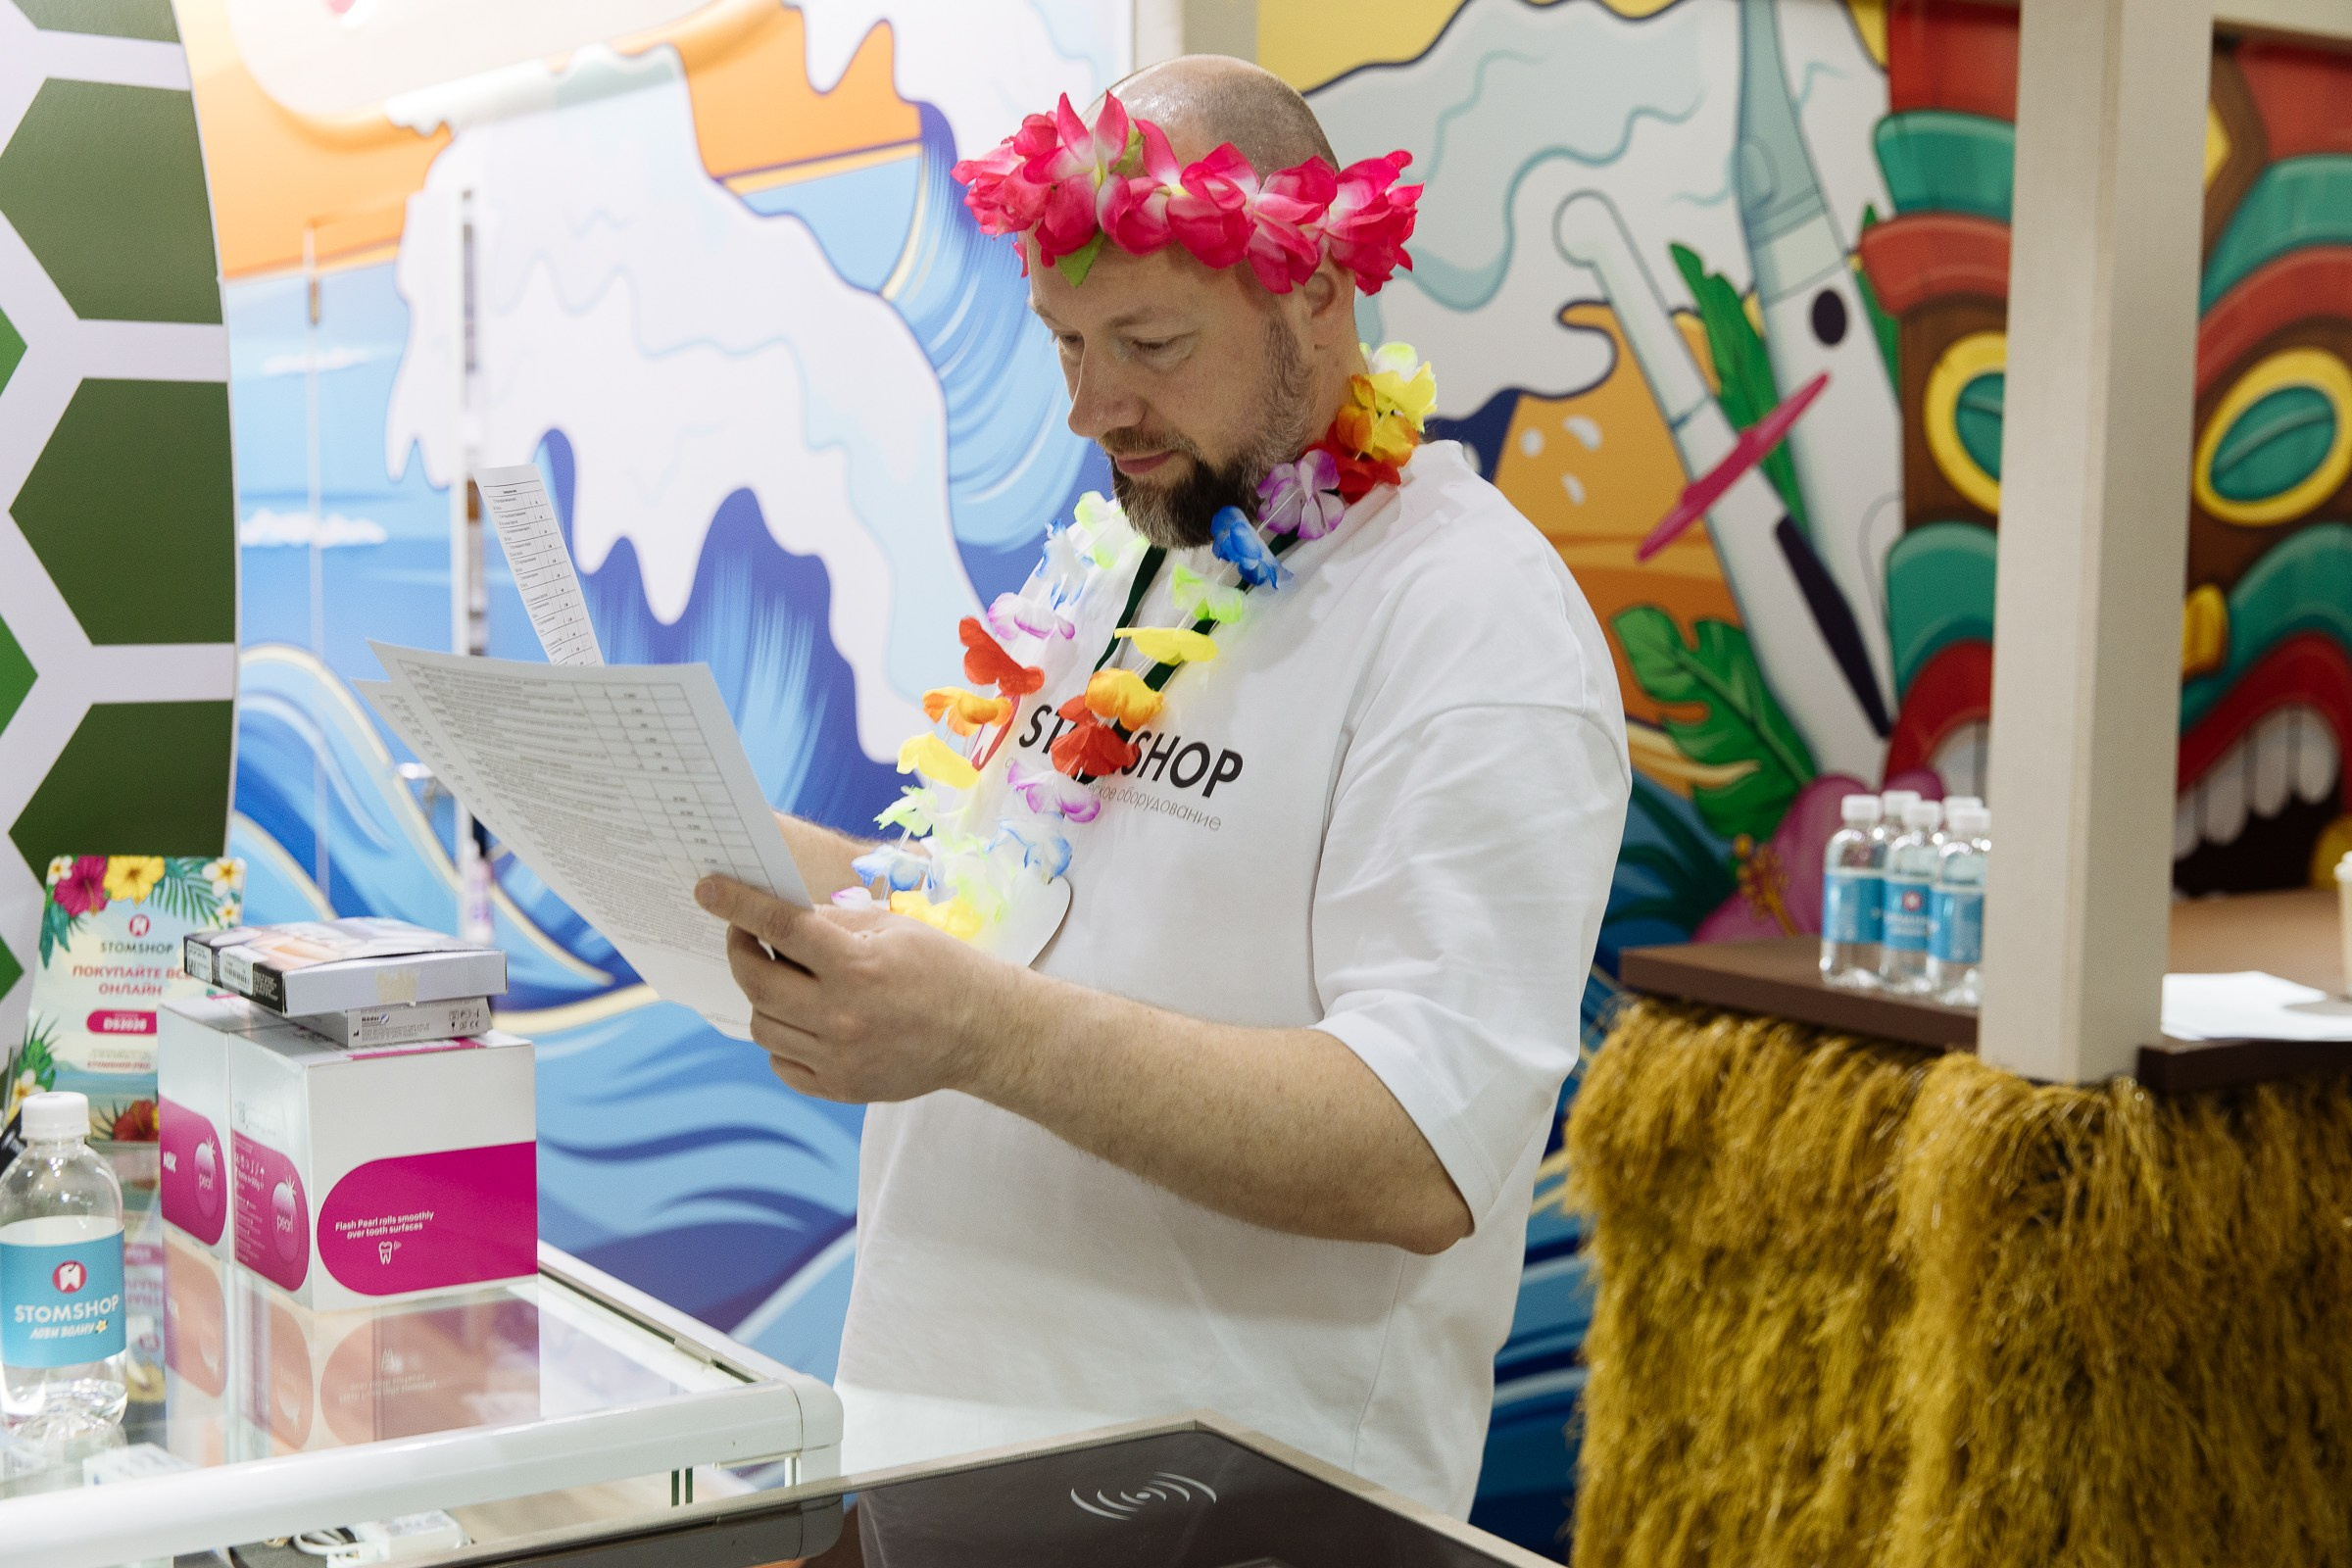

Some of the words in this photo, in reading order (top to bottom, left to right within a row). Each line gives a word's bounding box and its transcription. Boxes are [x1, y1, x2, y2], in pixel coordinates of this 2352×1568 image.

[1018, 704, 1244, 799] STSHOP
[1117, 787, 1222, 831] оборудование
[100, 941, 173, 955] STOMSHOP
[73, 964, 162, 979] ПОКУПАЙТЕ
[98, 982, 164, 997] ОНЛАЙН
[335, 1219, 357, 1232] Flash
[358, 1217, 379, 1229] Pearl
[379, 1215, 397, 1226] rolls
[397, 1210, 434, 1222] smoothly
[346, 1230, 366, 1240] over
[366, 1226, 388, 1237] tooth
[389, 1222, 423, 1234] surfaces
[15, 1295, 119, 1323] STOMSHOP
